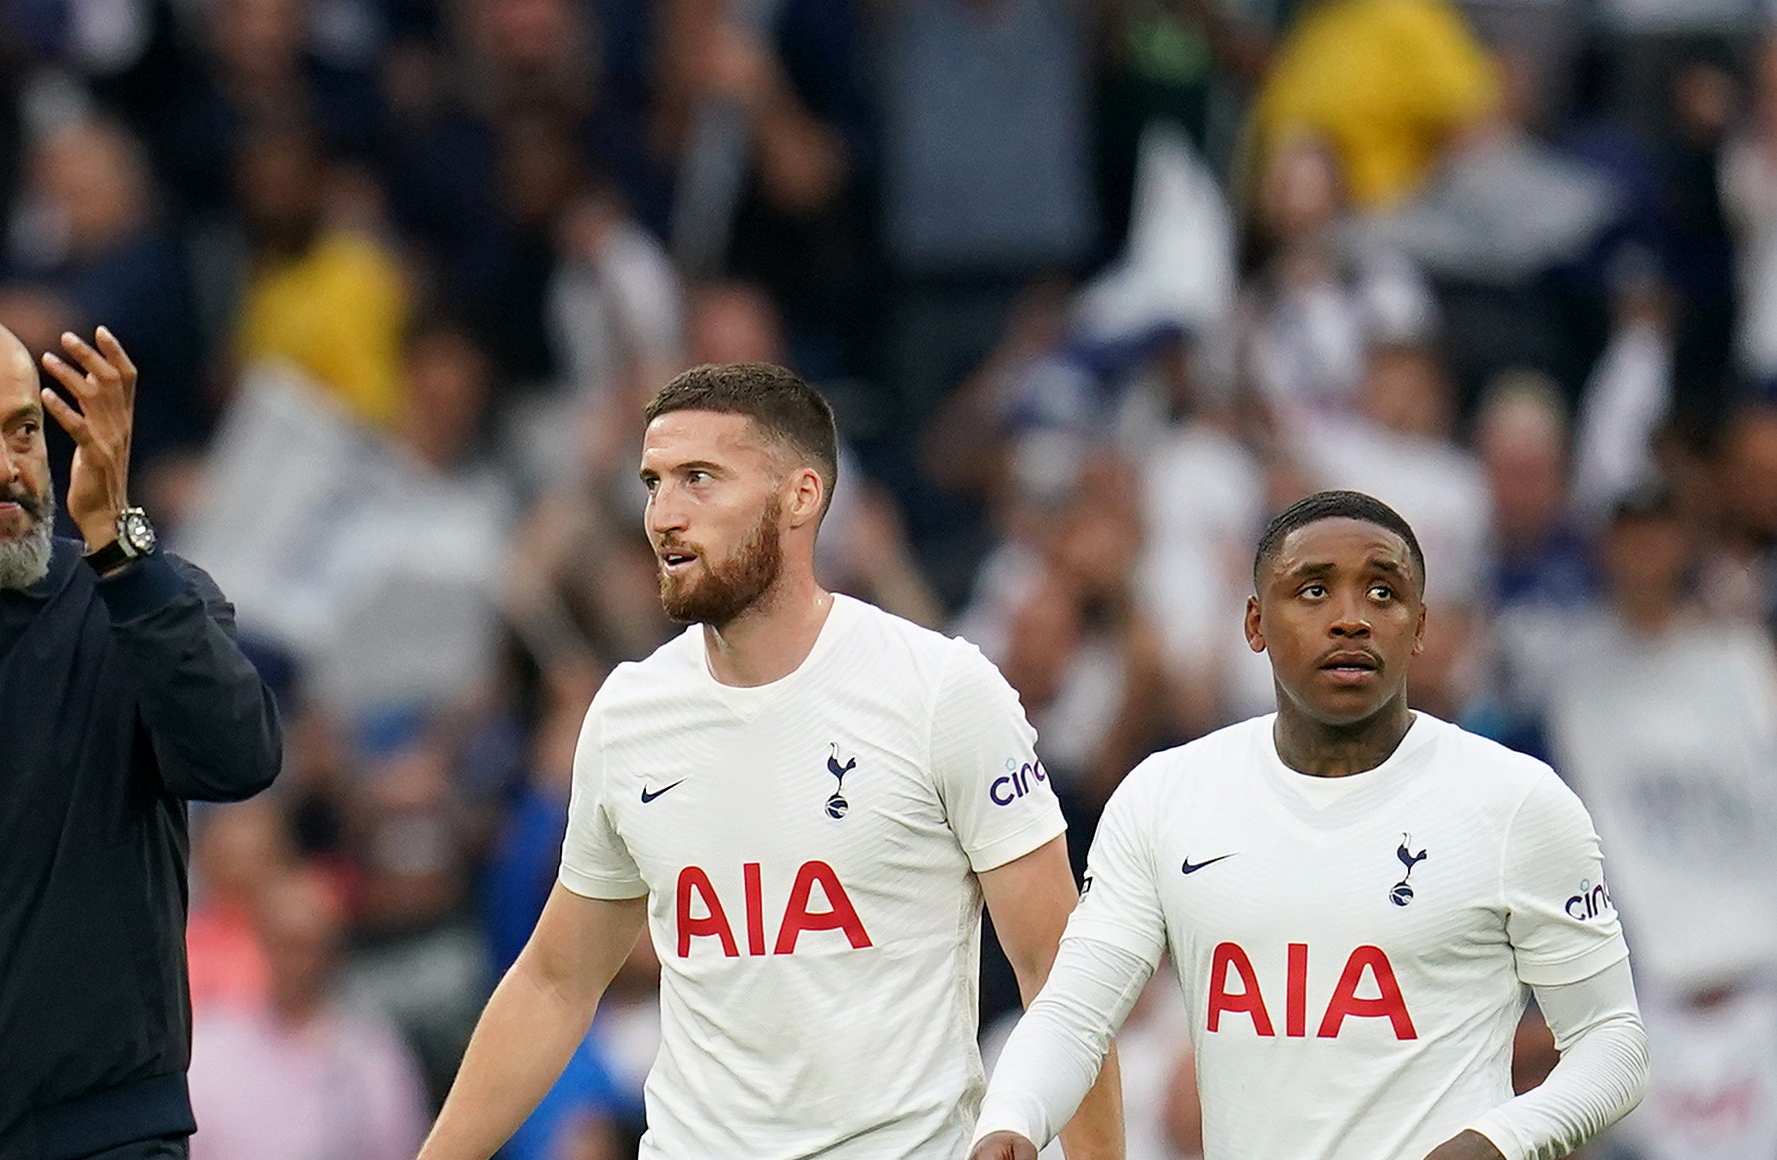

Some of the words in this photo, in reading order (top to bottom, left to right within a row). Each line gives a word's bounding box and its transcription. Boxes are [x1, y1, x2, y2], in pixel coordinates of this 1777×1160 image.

[677, 860, 874, 958] AIA
[1565, 879, 1610, 921] cin
[1207, 941, 1418, 1041] AIA
